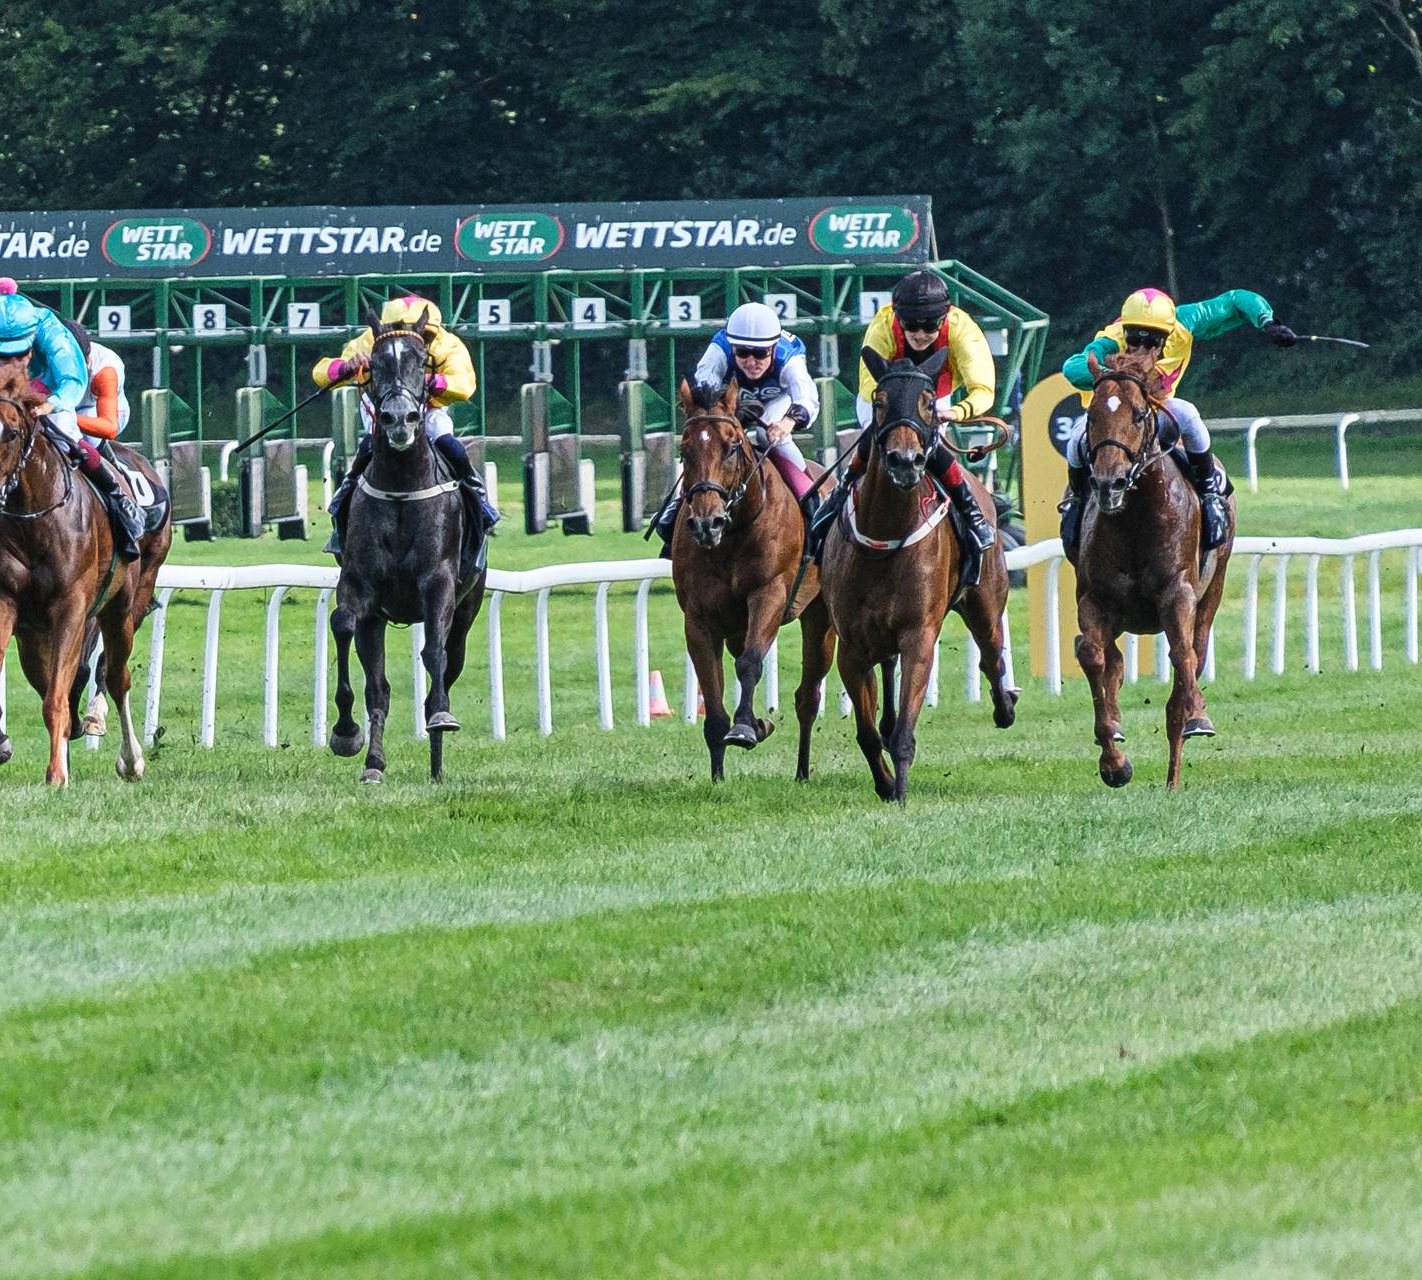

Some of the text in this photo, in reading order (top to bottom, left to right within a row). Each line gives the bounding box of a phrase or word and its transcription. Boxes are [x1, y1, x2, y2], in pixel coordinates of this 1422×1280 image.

[474, 220, 537, 238] WETT
[828, 212, 892, 231] WETT
[122, 225, 184, 243] WETT
[222, 226, 442, 255] WETTSTAR.de
[575, 219, 797, 248] WETTSTAR.de
[842, 230, 901, 249] STAR
[136, 243, 194, 261] STAR
[488, 237, 546, 256] STAR
[488, 304, 501, 324] 5
[583, 303, 596, 322] 4
[678, 301, 692, 321] 3
[774, 299, 787, 319] 2
[870, 297, 879, 317] 1
[108, 311, 121, 330] 9
[203, 309, 216, 330] 8
[297, 308, 312, 328] 7
